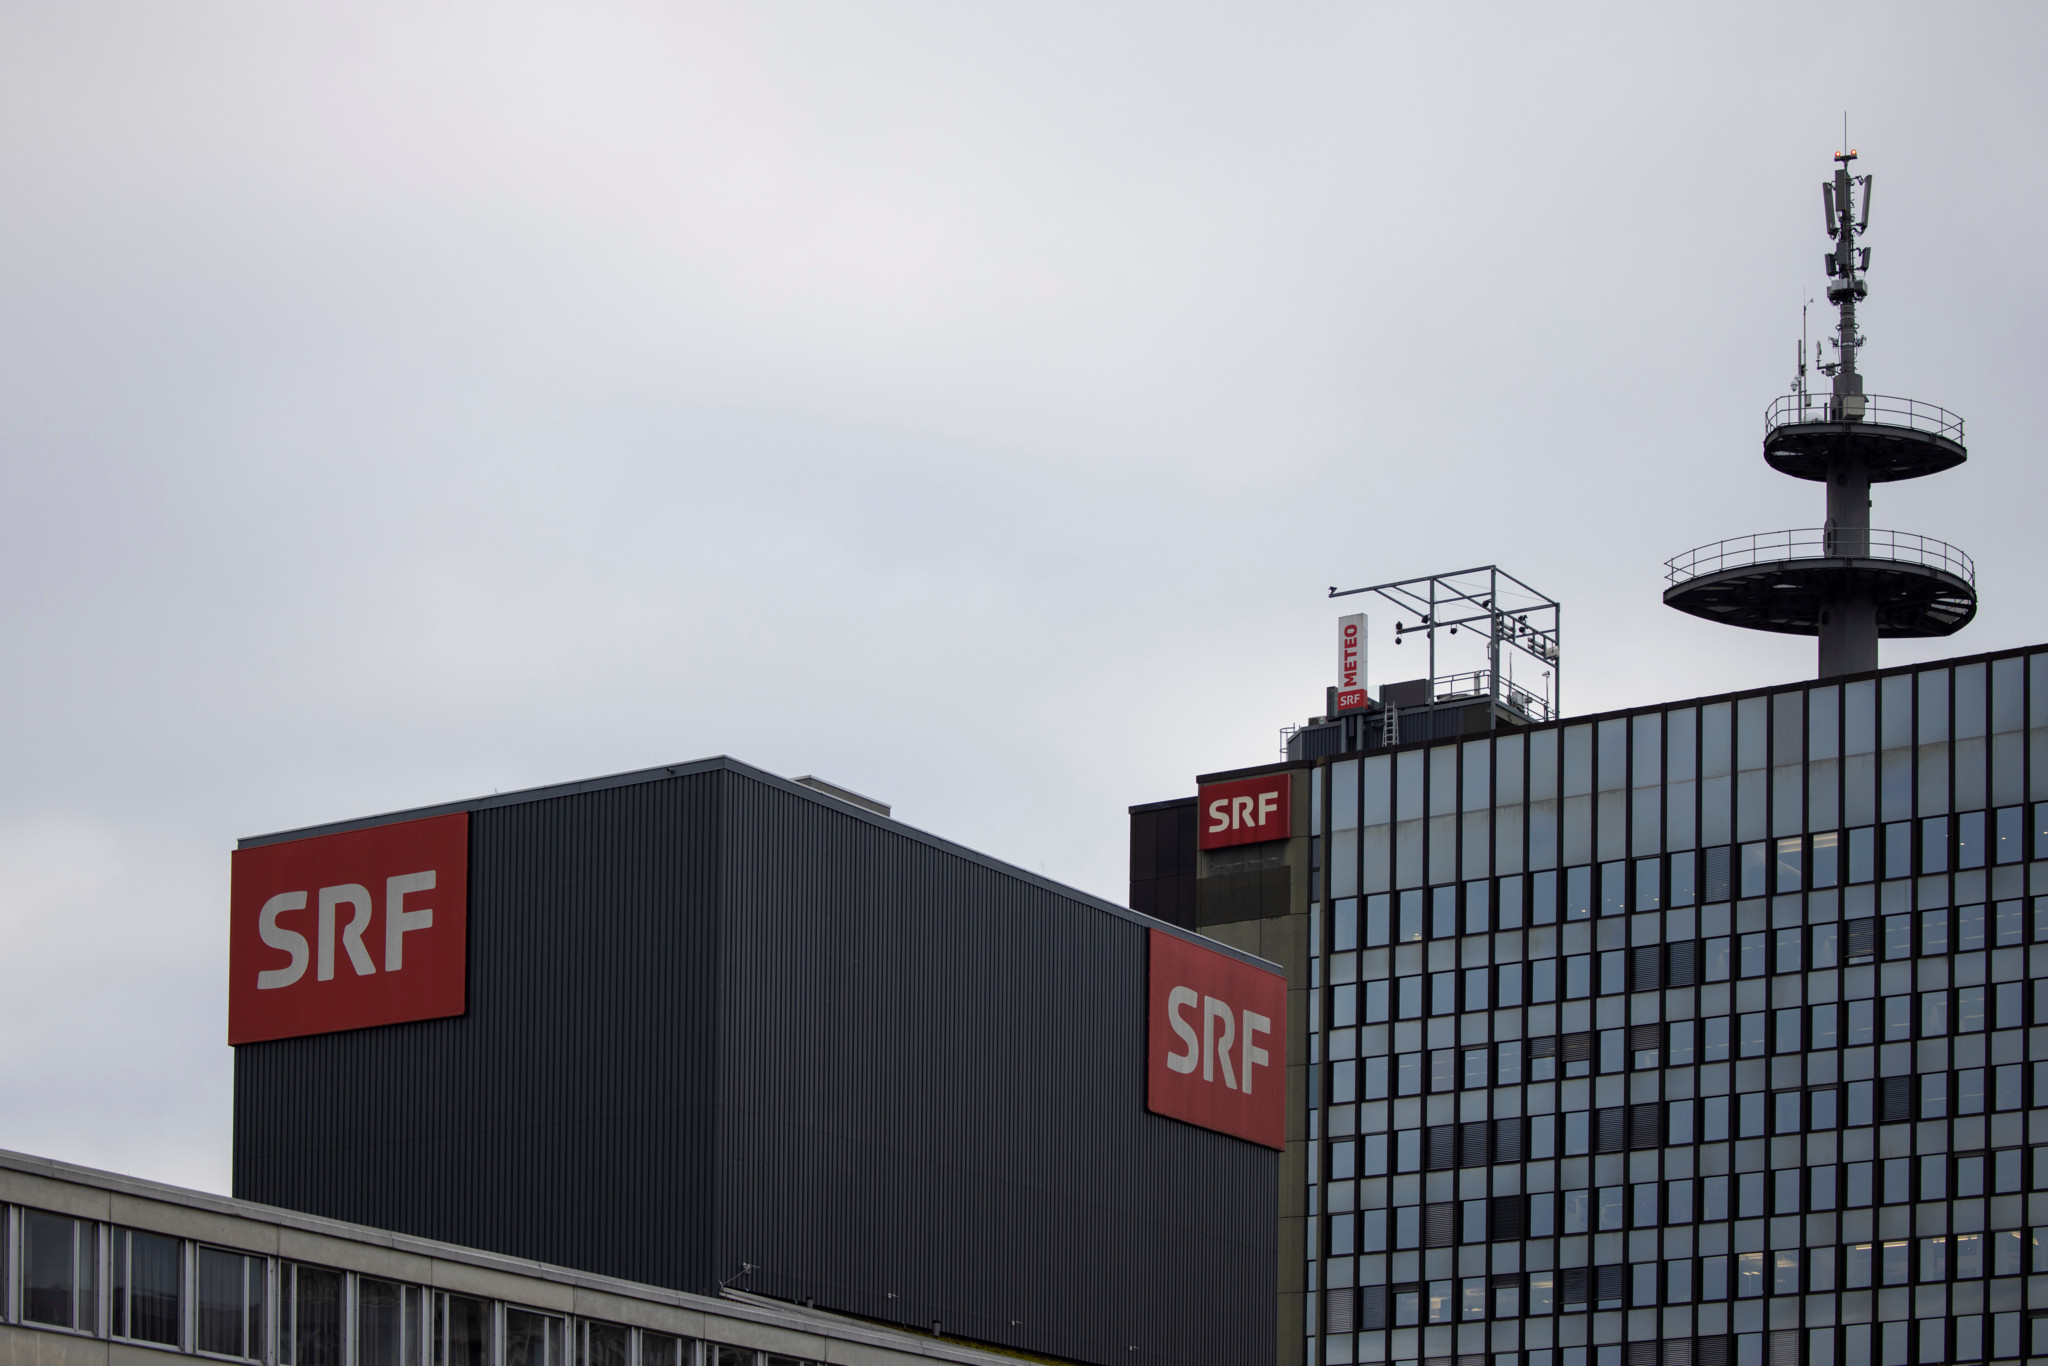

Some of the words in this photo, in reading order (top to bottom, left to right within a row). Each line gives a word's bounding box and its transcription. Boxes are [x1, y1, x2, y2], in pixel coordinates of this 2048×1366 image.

[1344, 624, 1358, 688] METEO
[1340, 694, 1361, 706] SRF
[1208, 791, 1279, 833] SRF
[257, 870, 437, 990] SRF
[1166, 985, 1271, 1095] SRF
